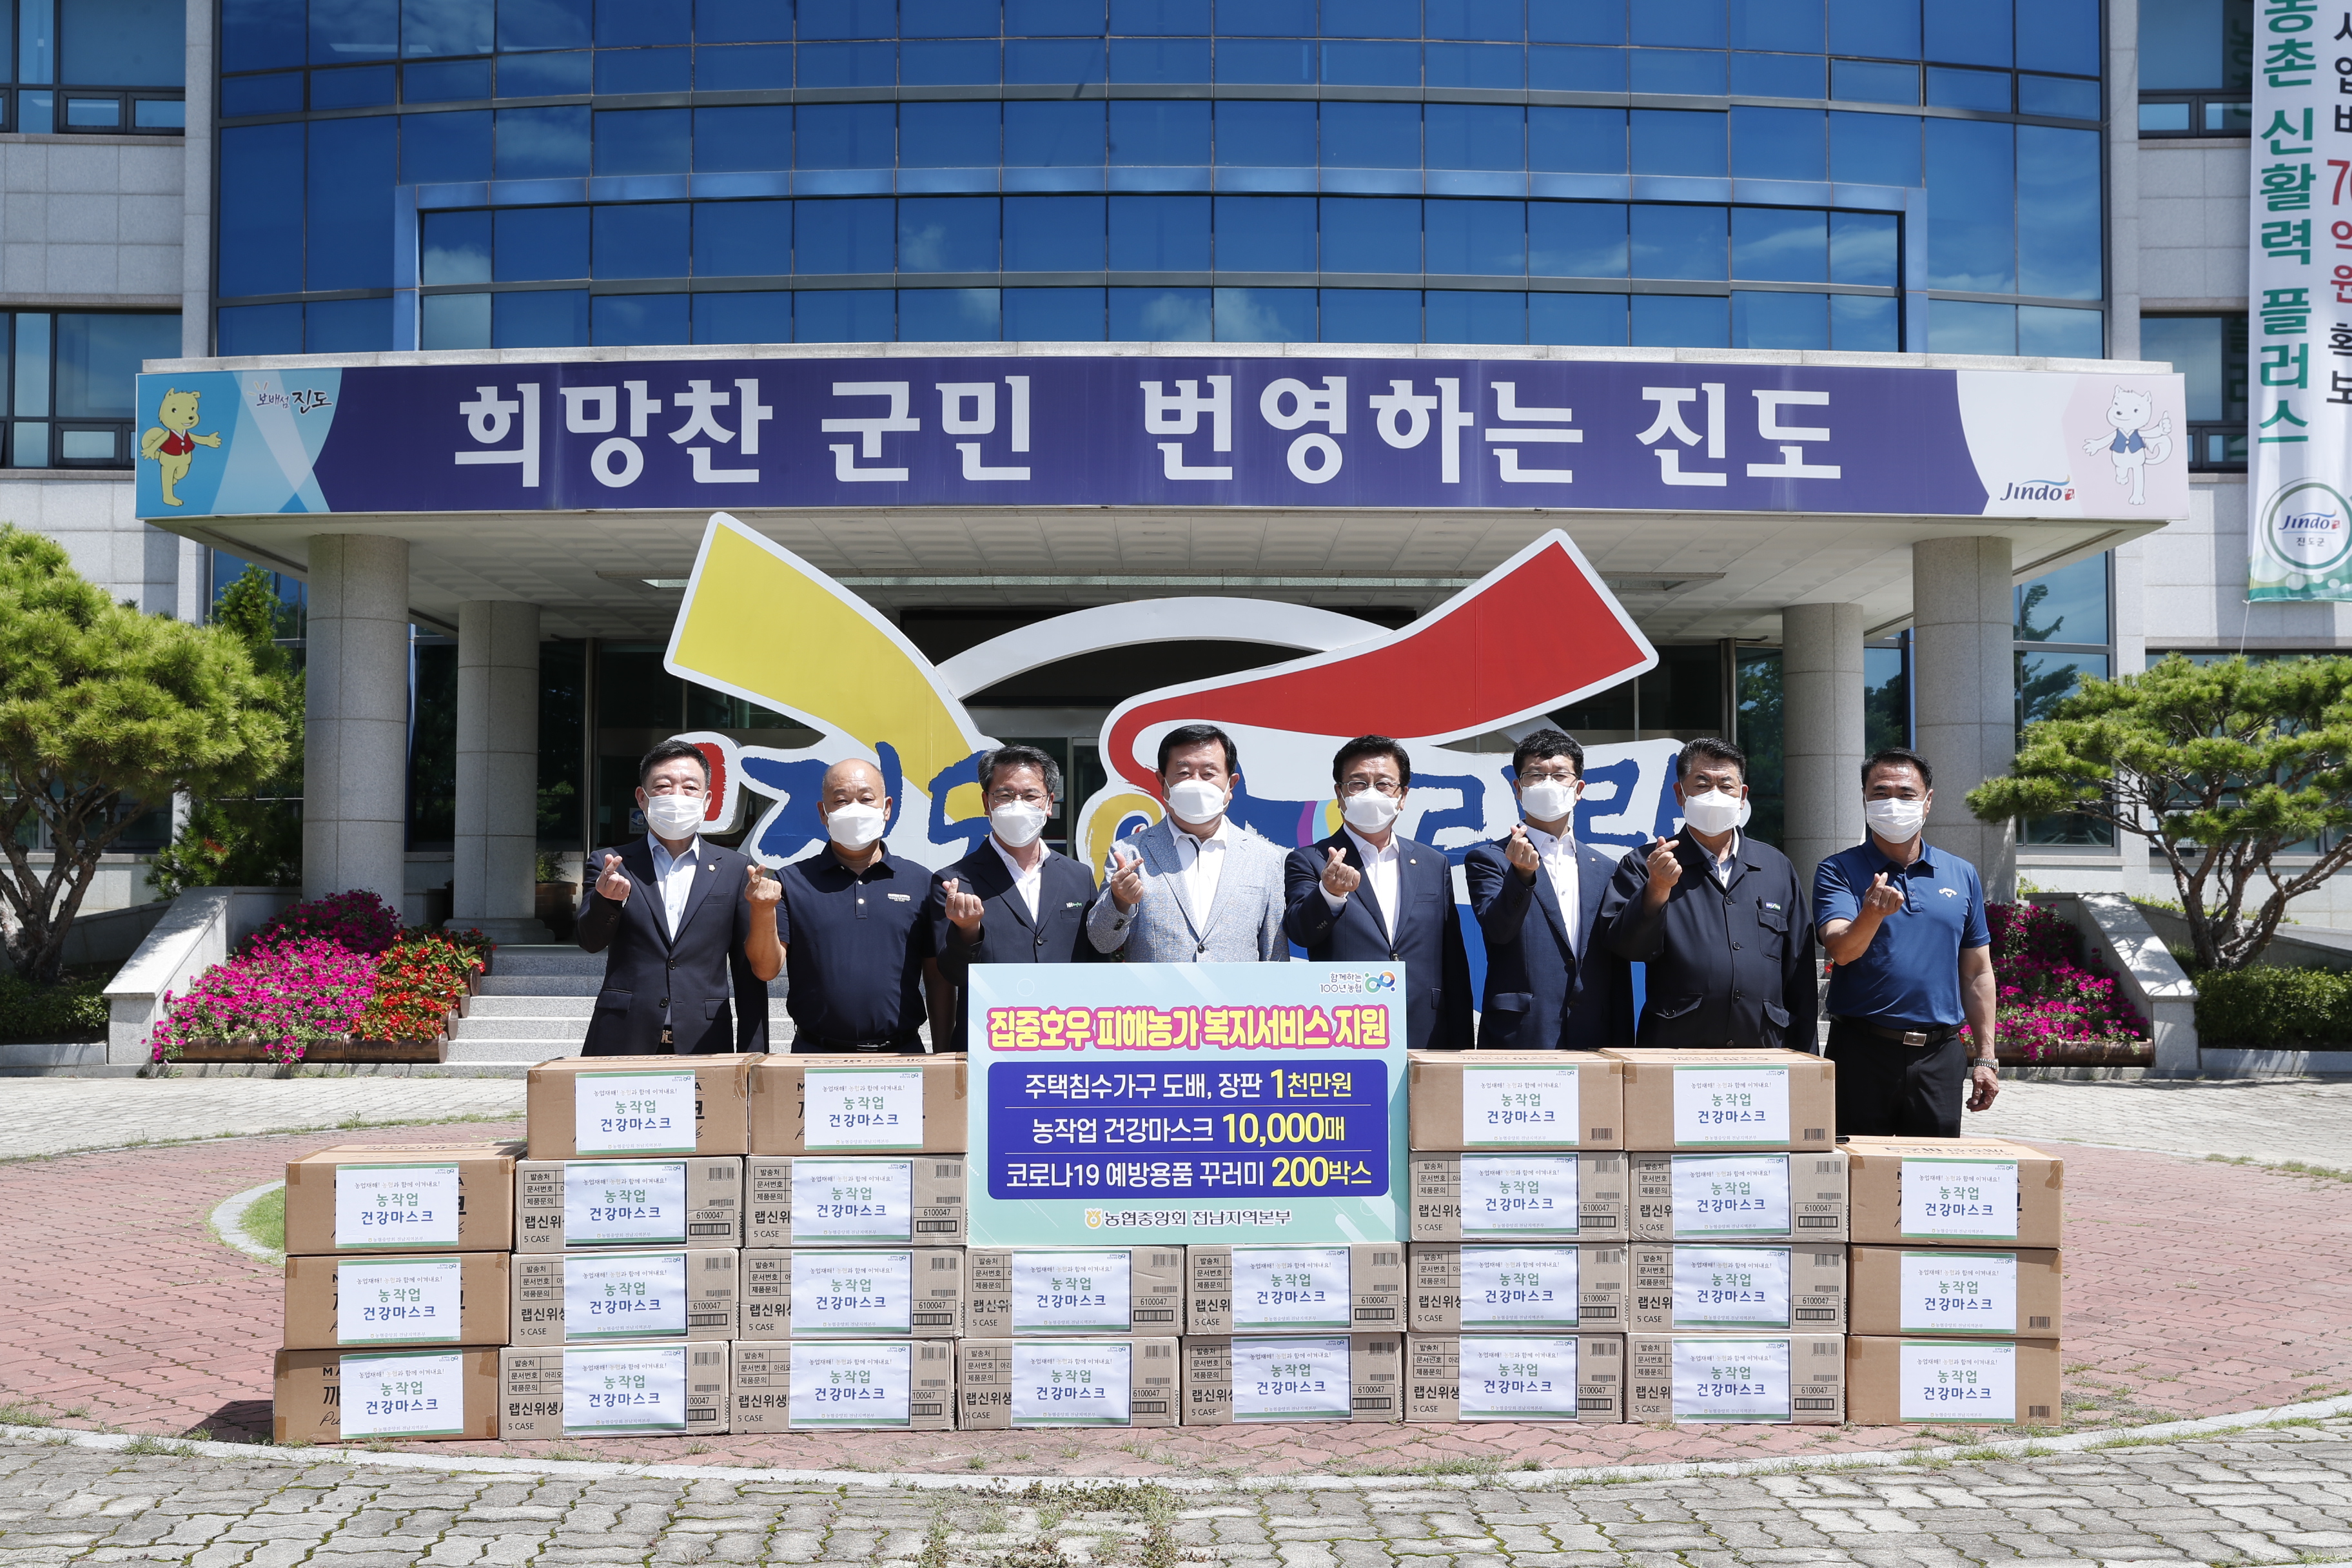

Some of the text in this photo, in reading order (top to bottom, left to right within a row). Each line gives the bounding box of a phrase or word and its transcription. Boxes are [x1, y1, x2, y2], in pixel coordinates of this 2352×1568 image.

[2259, 107, 2317, 266] 신활력
[2258, 287, 2312, 444] 플러스
[257, 389, 333, 414] 보배섬 진도
[455, 375, 1841, 488] 희망찬 군민 번영하는 진도
[1999, 482, 2063, 501] Jindo
[2278, 514, 2330, 530] Jindo
[1331, 972, 1362, 983] 함께하는
[990, 1007, 1387, 1048] 집중호우 피해농가 복지서비스 지원
[1025, 1070, 1352, 1099] 주택침수가구 도배, 장판 1천만원
[843, 1097, 883, 1110] 농작업
[1502, 1093, 1540, 1106] 농작업
[1712, 1093, 1750, 1106] 농작업
[615, 1100, 655, 1114] 농작업
[830, 1114, 898, 1127] 건강마스크
[1487, 1111, 1555, 1124] 건강마스크
[1698, 1111, 1765, 1124] 건강마스크
[601, 1118, 671, 1132] 건강마스크
[1032, 1113, 1345, 1147] 농작업 건강마스크 10,000매
[1007, 1157, 1372, 1188] 코로나19 예방용품 꾸러미 200박스
[831, 1188, 871, 1200] 농작업
[1500, 1181, 1538, 1194] 농작업
[1711, 1182, 1750, 1195] 농작업
[1939, 1186, 1979, 1200] 농작업
[377, 1193, 418, 1207] 농작업
[605, 1190, 645, 1203] 농작업
[1485, 1198, 1553, 1211] 건강마스크
[1698, 1199, 1765, 1212] 건강마스크
[1926, 1204, 1993, 1217] 건강마스크
[362, 1211, 433, 1225] 건강마스크
[590, 1207, 660, 1220] 건강마스크
[817, 1205, 886, 1218] 건강마스크
[1104, 1209, 1292, 1226] 농협중앙회 전남지역본부
[523, 1277, 549, 1286] 문서번호
[831, 1279, 871, 1292] 농작업
[1051, 1278, 1090, 1291] 농작업
[1271, 1274, 1310, 1287] 농작업
[1499, 1273, 1538, 1286] 농작업
[1712, 1273, 1750, 1287] 농작업
[604, 1282, 645, 1297] 농작업
[1939, 1281, 1977, 1294] 농작업
[378, 1288, 420, 1302] 농작업
[1037, 1295, 1106, 1308] 건강마스크
[1257, 1291, 1326, 1304] 건강마스크
[1485, 1290, 1553, 1303] 건강마스크
[1698, 1290, 1765, 1303] 건강마스크
[590, 1300, 661, 1314] 건강마스크
[816, 1297, 886, 1310] 건강마스크
[1925, 1298, 1992, 1311] 건강마스크
[364, 1306, 435, 1320] 건강마스크
[1051, 1370, 1090, 1383] 농작업
[1271, 1364, 1310, 1377] 농작업
[1498, 1364, 1537, 1377] 농작업
[1711, 1367, 1750, 1380] 농작업
[1937, 1370, 1976, 1383] 농작업
[604, 1375, 645, 1389] 농작업
[830, 1371, 870, 1384] 농작업
[381, 1381, 422, 1396] 농작업
[1257, 1381, 1326, 1395] 건강마스크
[1484, 1380, 1552, 1393] 건강마스크
[1698, 1384, 1765, 1396] 건강마스크
[589, 1393, 660, 1407] 건강마스크
[816, 1388, 885, 1401] 건강마스크
[1037, 1387, 1105, 1400] 건강마스크
[1924, 1387, 1991, 1400] 건강마스크
[366, 1399, 438, 1415] 건강마스크
